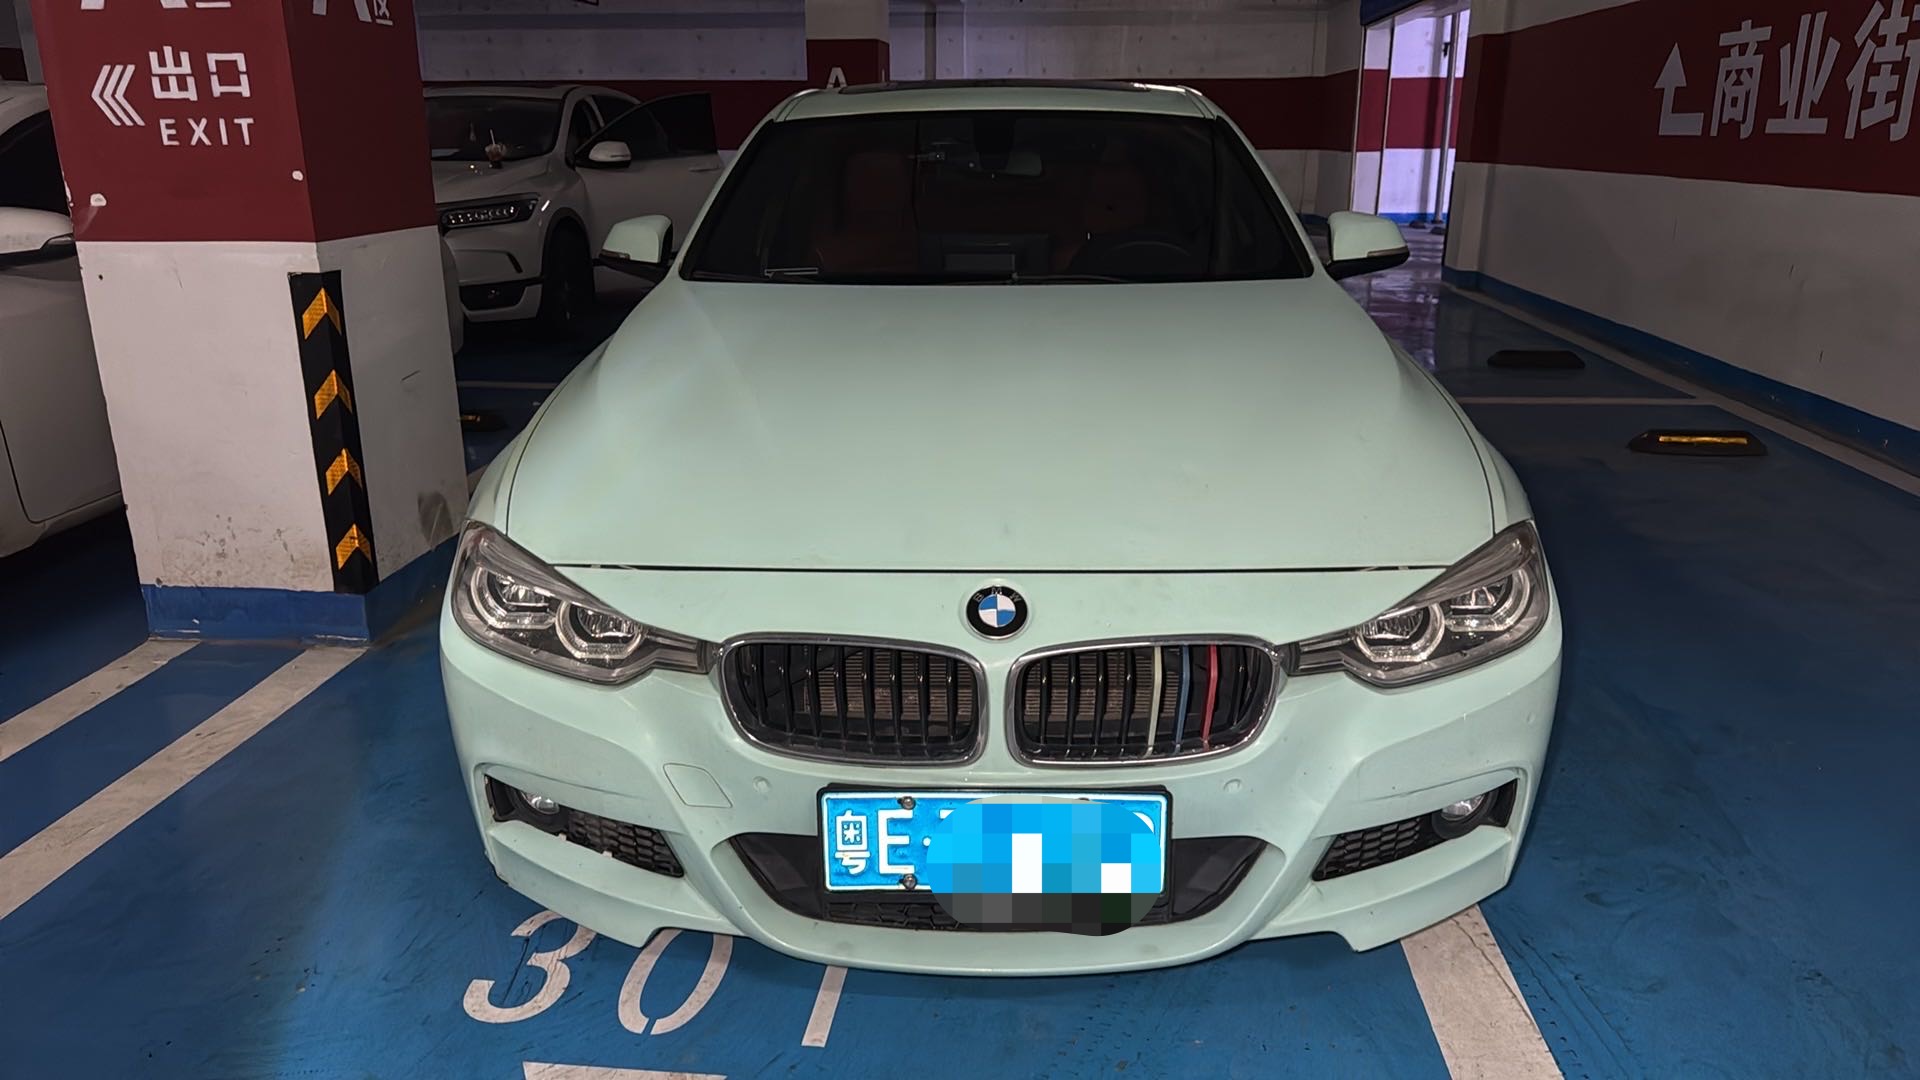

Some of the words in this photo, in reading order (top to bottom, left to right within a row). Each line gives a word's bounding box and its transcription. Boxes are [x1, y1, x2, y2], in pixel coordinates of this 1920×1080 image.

[149, 46, 250, 101] 出口
[1710, 0, 1920, 141] 商业街
[160, 118, 254, 145] EXIT
[973, 586, 1021, 602] BMW
